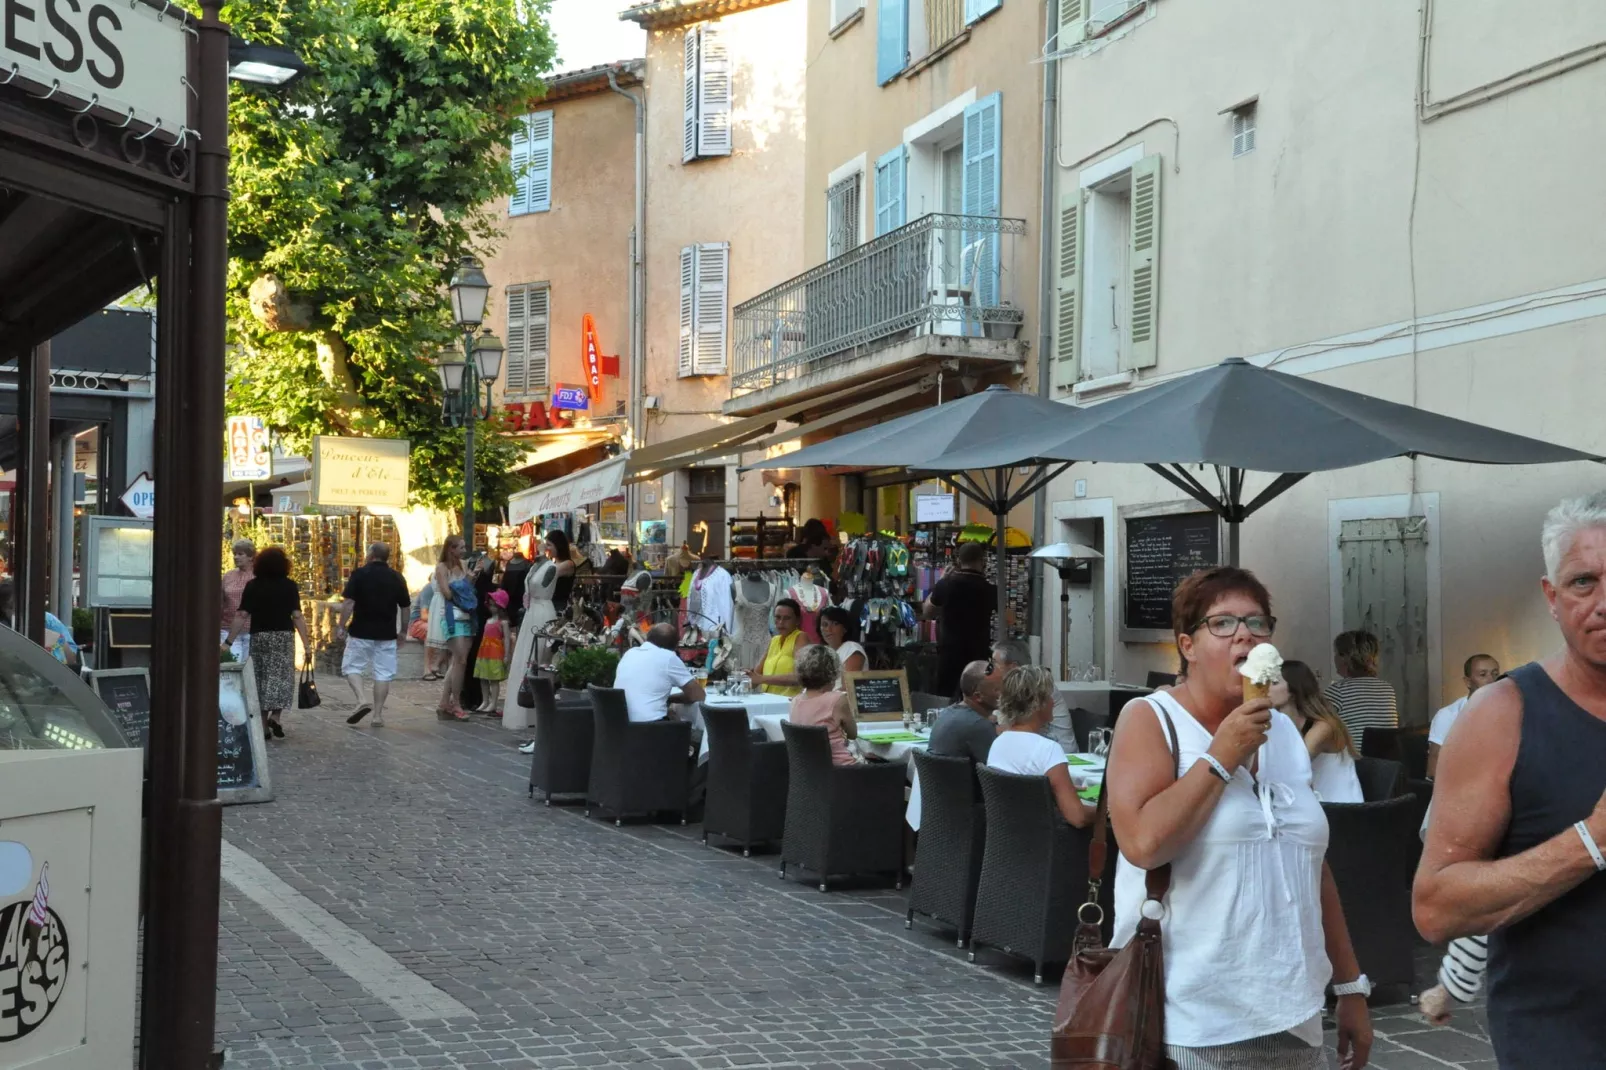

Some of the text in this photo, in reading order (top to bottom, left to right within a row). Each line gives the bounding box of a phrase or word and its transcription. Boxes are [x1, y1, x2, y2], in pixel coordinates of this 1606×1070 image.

[5, 0, 124, 89] ESS
[587, 331, 599, 385] TABAC
[559, 391, 574, 401] FDJ
